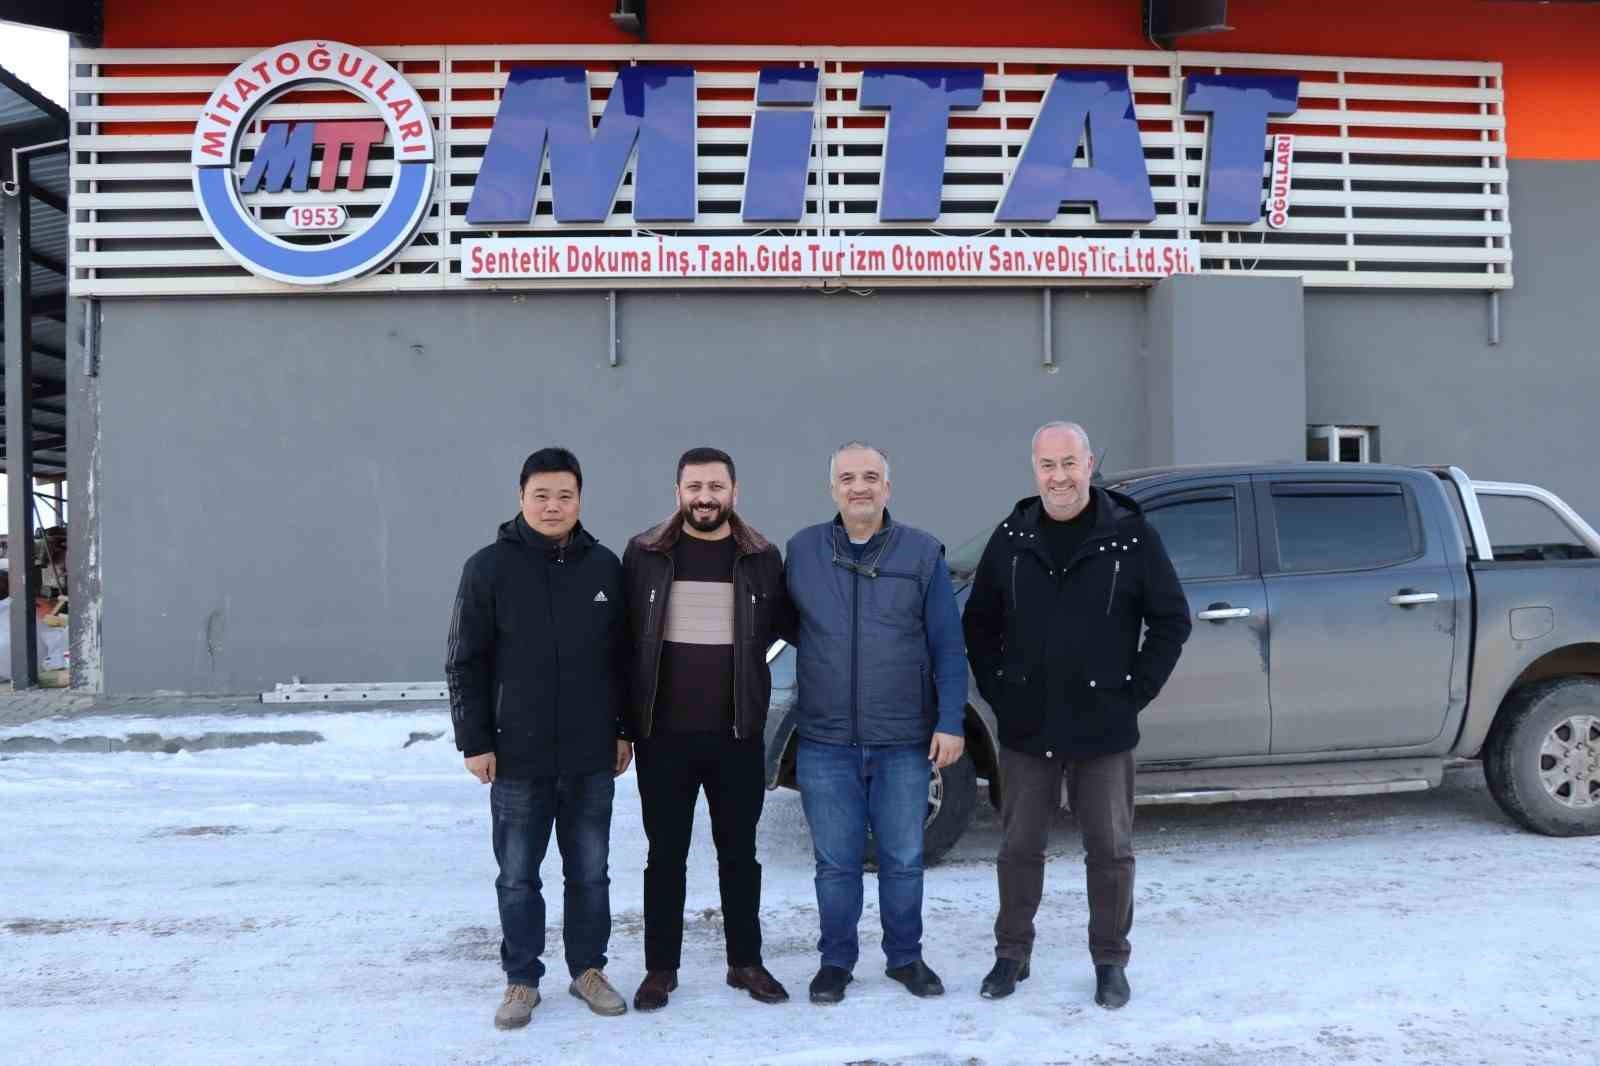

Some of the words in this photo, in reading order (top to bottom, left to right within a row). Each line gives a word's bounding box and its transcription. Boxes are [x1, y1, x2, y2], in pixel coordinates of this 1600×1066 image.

[200, 43, 427, 158] MİTATOĞULLARI
[240, 120, 386, 193] MTT
[292, 208, 338, 225] 1953
[471, 246, 560, 273] Sentetik
[567, 246, 651, 273] Dokuma
[891, 243, 983, 272] Otomotiv
